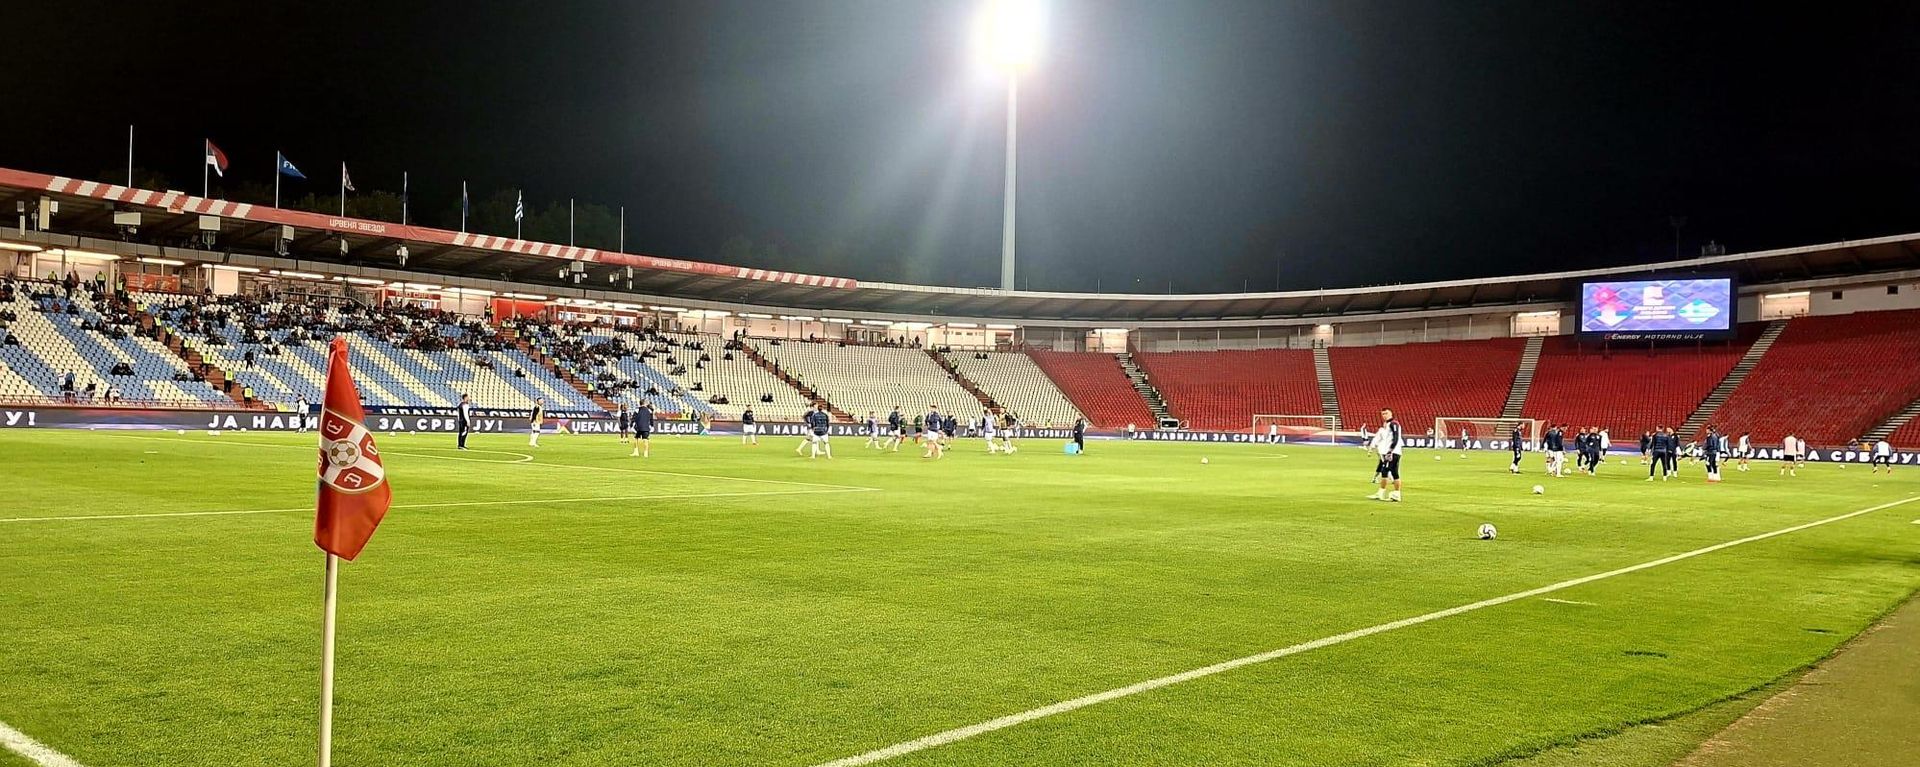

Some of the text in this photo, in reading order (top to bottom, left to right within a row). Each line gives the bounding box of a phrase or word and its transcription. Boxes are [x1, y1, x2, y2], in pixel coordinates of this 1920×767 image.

[329, 219, 386, 233] ЦРВЕНА ЗВЕЗДА
[208, 415, 239, 428] ЈА
[378, 418, 503, 431] ЗА СРБЈУ!
[572, 421, 602, 432] UEFA
[657, 422, 699, 433] LEAGUE
[838, 426, 857, 435] ЗА
[1132, 431, 1147, 439] ЈА
[1153, 432, 1208, 441] НАВИЈАМ
[1212, 433, 1228, 442] ЗА
